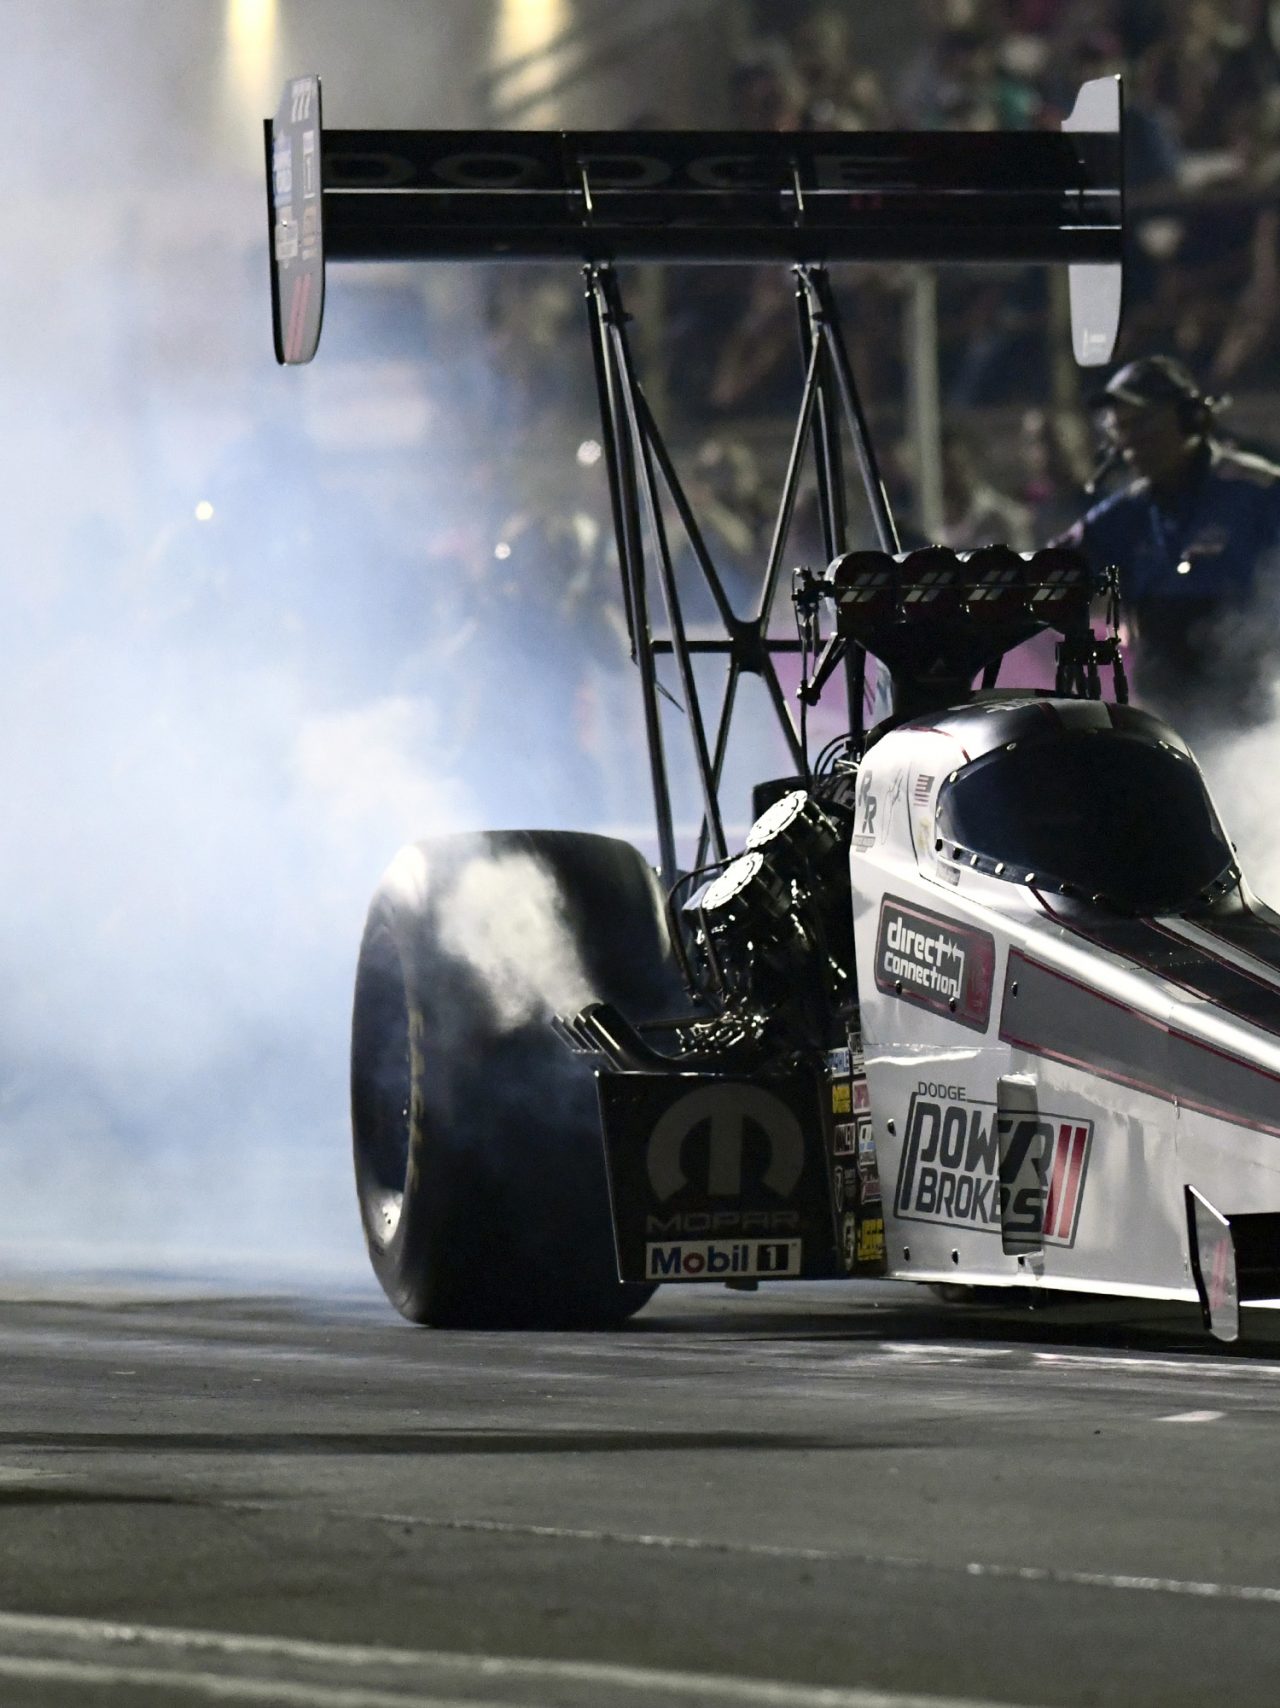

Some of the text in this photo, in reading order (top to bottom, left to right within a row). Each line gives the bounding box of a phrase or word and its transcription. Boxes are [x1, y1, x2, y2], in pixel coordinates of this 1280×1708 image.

[322, 151, 917, 189] DODGE
[887, 916, 947, 967] direct
[883, 951, 961, 1000] connection
[918, 1081, 966, 1101] DODGE
[645, 1210, 799, 1233] MOPAR
[651, 1244, 748, 1275] Mobil
